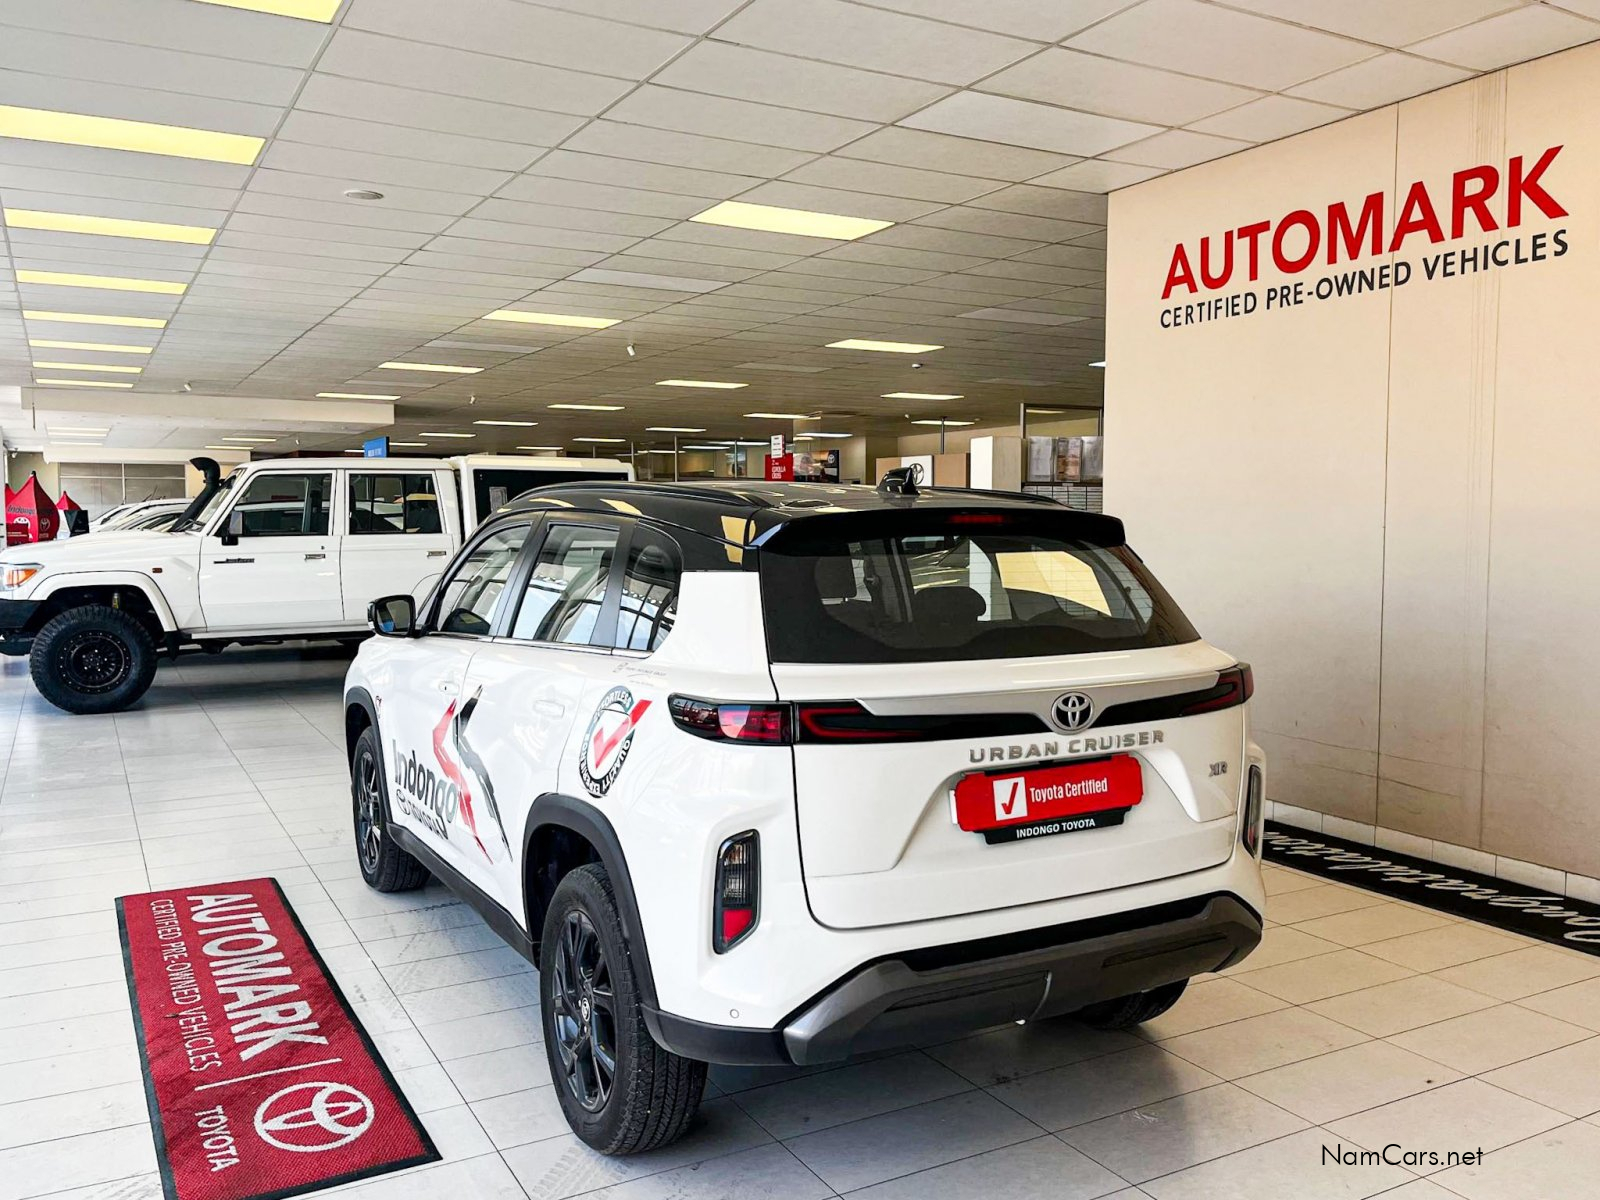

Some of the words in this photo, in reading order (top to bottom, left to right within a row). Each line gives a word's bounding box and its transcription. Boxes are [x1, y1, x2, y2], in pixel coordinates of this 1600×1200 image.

[1160, 144, 1570, 300] AUTOMARK
[1160, 291, 1258, 329] CERTIFIED
[1265, 260, 1412, 312] PRE-OWNED
[1421, 228, 1569, 282] VEHICLES
[968, 740, 1058, 764] URBAN
[1068, 729, 1165, 754] CRUISER
[392, 738, 458, 824] Indongo
[1029, 783, 1064, 804] Toyota
[1064, 776, 1109, 797] Certified
[1016, 822, 1059, 839] INDONGO
[1061, 817, 1096, 833] TOYOTA
[149, 898, 182, 942] CERTIFIED
[161, 941, 201, 1004] PRE-OWNED
[186, 893, 331, 1063] AUTOMARK
[176, 1006, 223, 1073] VEHICLES
[194, 1104, 241, 1172] TOYOTA
